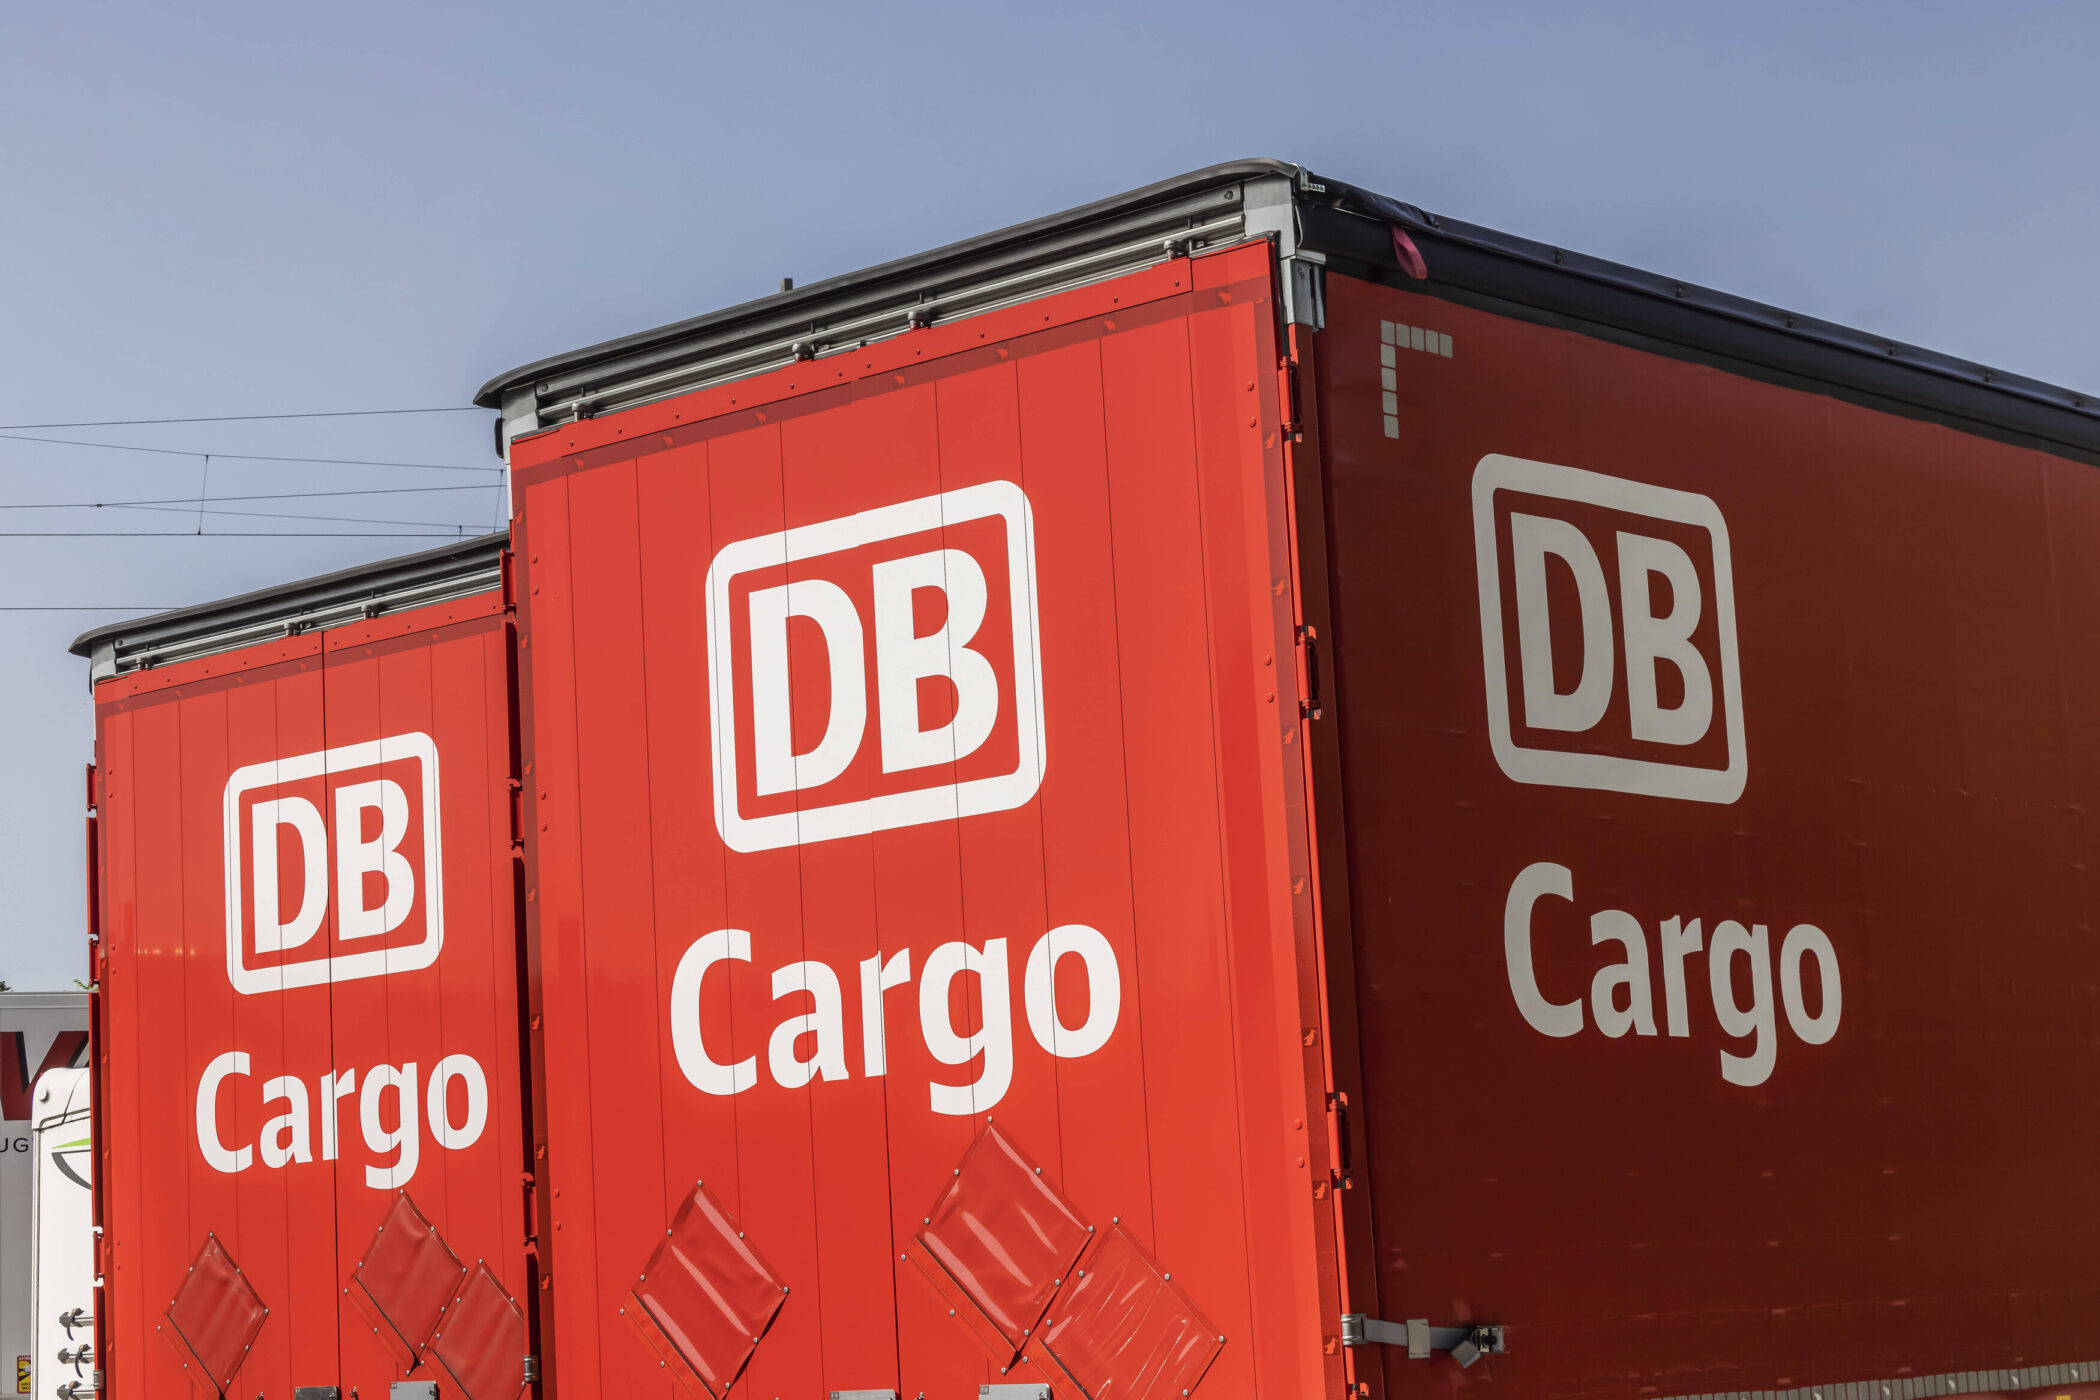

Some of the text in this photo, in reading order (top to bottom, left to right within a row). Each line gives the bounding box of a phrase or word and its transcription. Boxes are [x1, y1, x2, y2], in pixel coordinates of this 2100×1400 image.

[748, 548, 999, 797] DB
[1510, 511, 1715, 746] DB
[251, 779, 415, 955] DB
[670, 924, 1121, 1116] Cargo
[1503, 861, 1843, 1087] Cargo
[195, 1050, 489, 1190] Cargo
